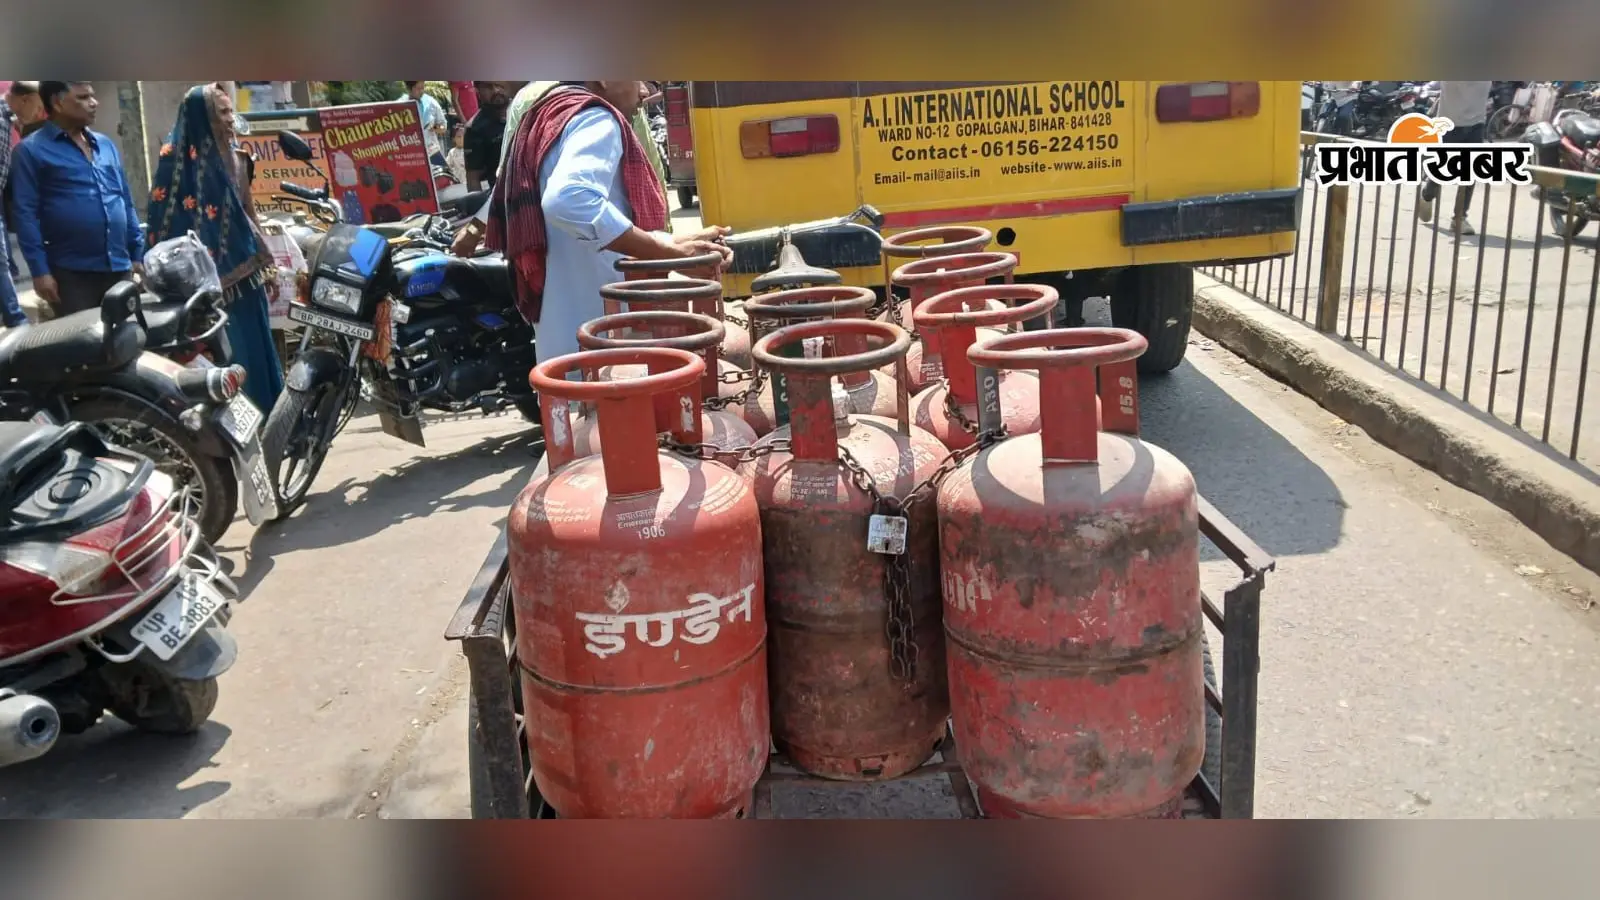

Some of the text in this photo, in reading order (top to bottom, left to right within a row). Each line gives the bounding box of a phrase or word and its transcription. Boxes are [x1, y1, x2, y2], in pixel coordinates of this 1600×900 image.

[1050, 81, 1124, 113] SCHOOL
[324, 108, 416, 149] Chaurasiya
[878, 127, 912, 142] WARD
[916, 124, 950, 140] NO-12
[351, 138, 400, 161] Shopping
[399, 132, 422, 147] Bag
[1119, 376, 1134, 416] 15.8
[638, 525, 665, 540] 1906
[142, 612, 168, 633] UP
[160, 596, 216, 649] BE 3883
[575, 582, 756, 659] इण्डेन
